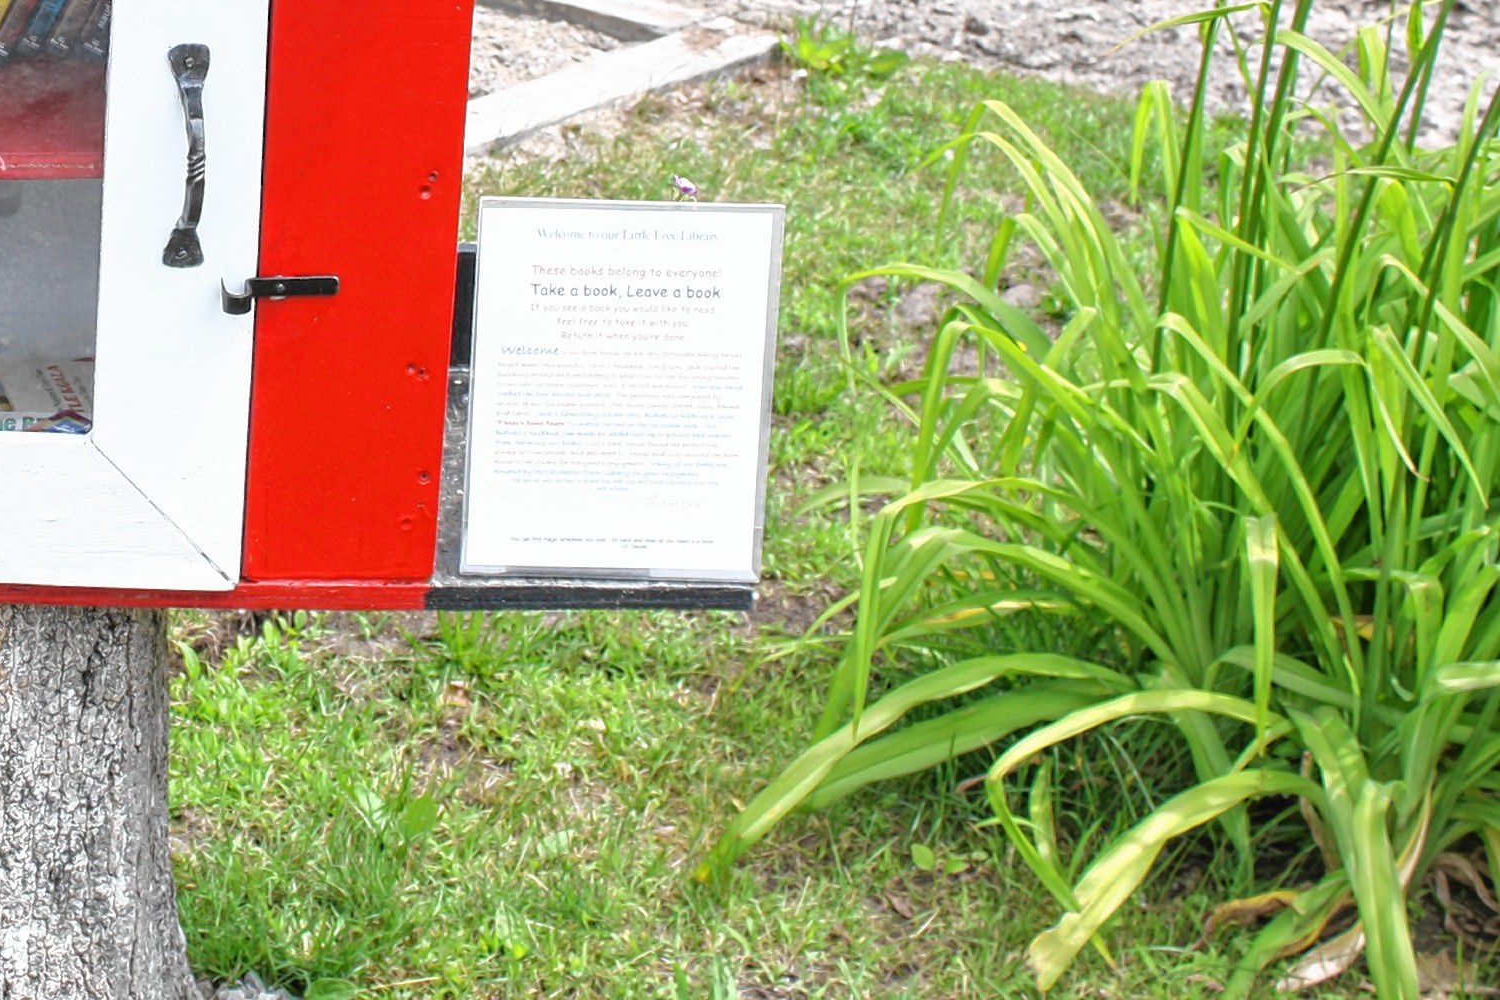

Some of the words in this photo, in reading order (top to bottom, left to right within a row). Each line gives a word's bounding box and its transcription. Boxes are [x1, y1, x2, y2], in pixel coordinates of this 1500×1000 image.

[536, 227, 585, 240] Welcome
[531, 264, 567, 277] These
[570, 265, 604, 278] books
[607, 266, 647, 280] belong
[650, 268, 662, 278] to
[530, 283, 566, 297] Take
[570, 287, 579, 297] a
[583, 283, 622, 300] book,
[626, 285, 669, 298] Leave
[673, 289, 682, 299] a
[686, 286, 721, 299] book
[501, 344, 560, 356] Welcome
